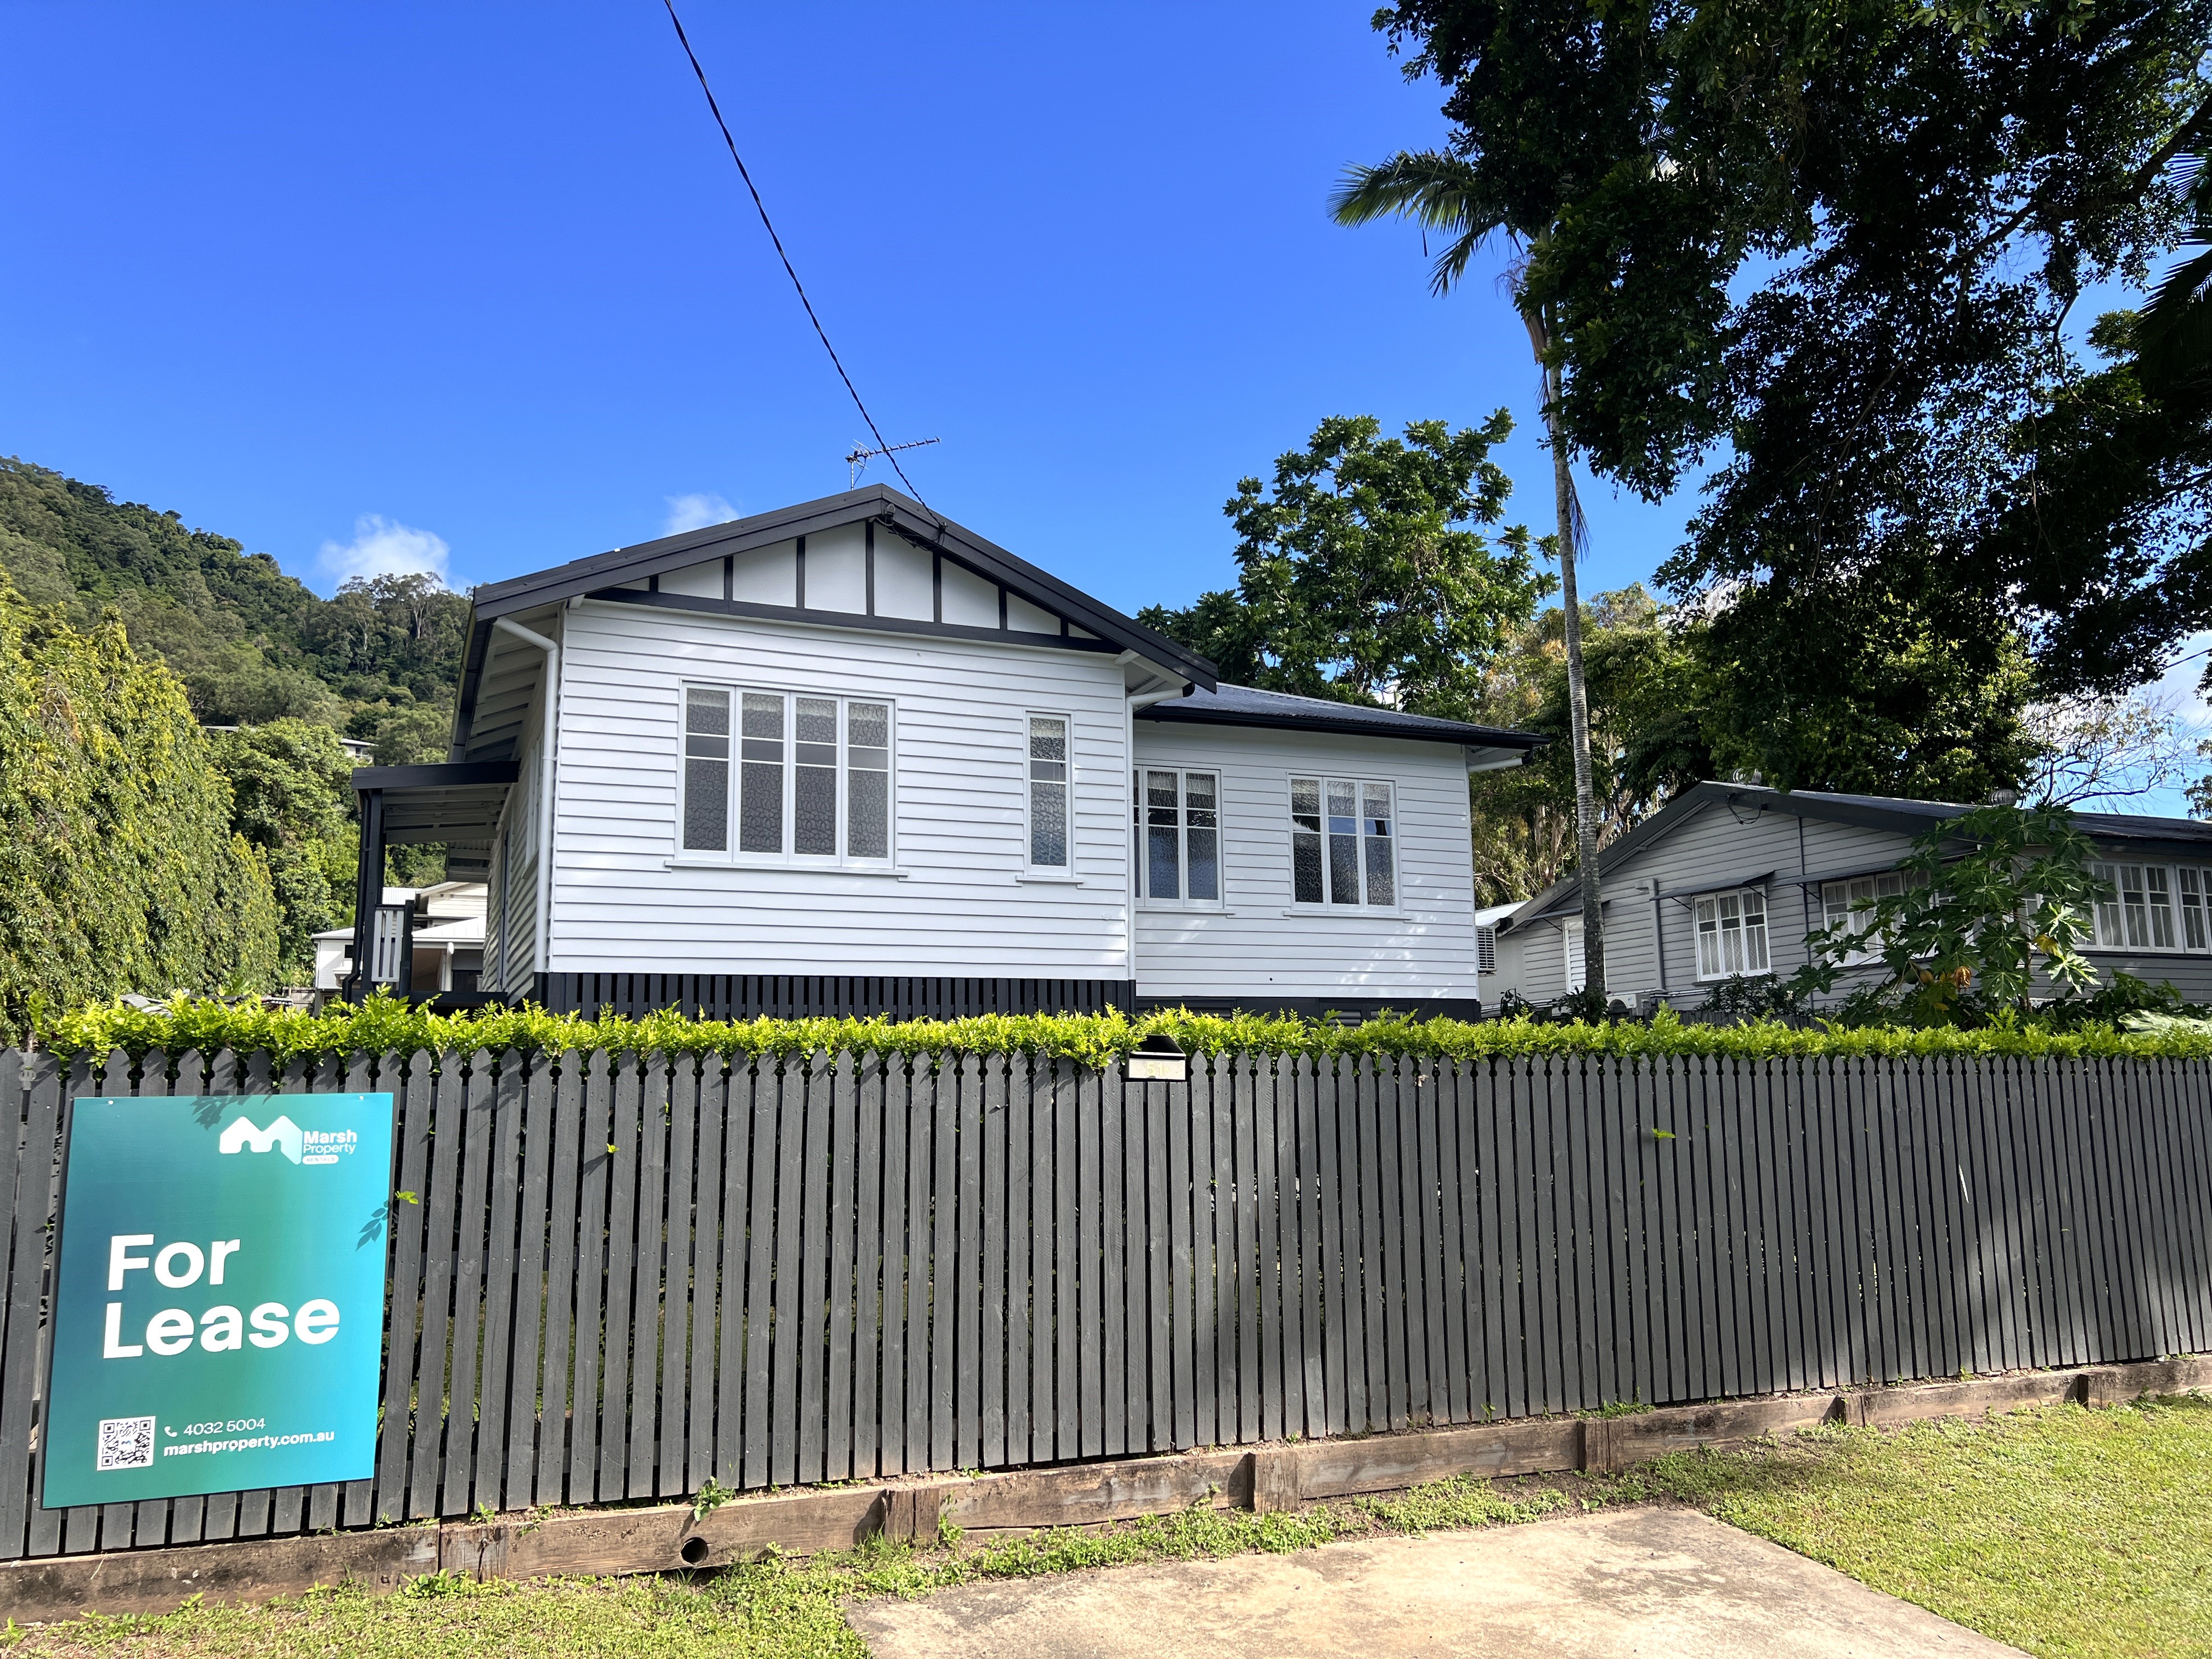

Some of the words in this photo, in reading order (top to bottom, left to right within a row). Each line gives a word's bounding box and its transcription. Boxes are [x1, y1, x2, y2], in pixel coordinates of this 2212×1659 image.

[303, 1129, 357, 1144] Marsh
[303, 1143, 356, 1155] Property
[108, 1234, 241, 1291] For
[103, 1299, 340, 1359] Lease
[183, 1422, 223, 1436] 4032
[226, 1418, 266, 1432] 5004
[163, 1430, 335, 1457] marshproperty.com.au
